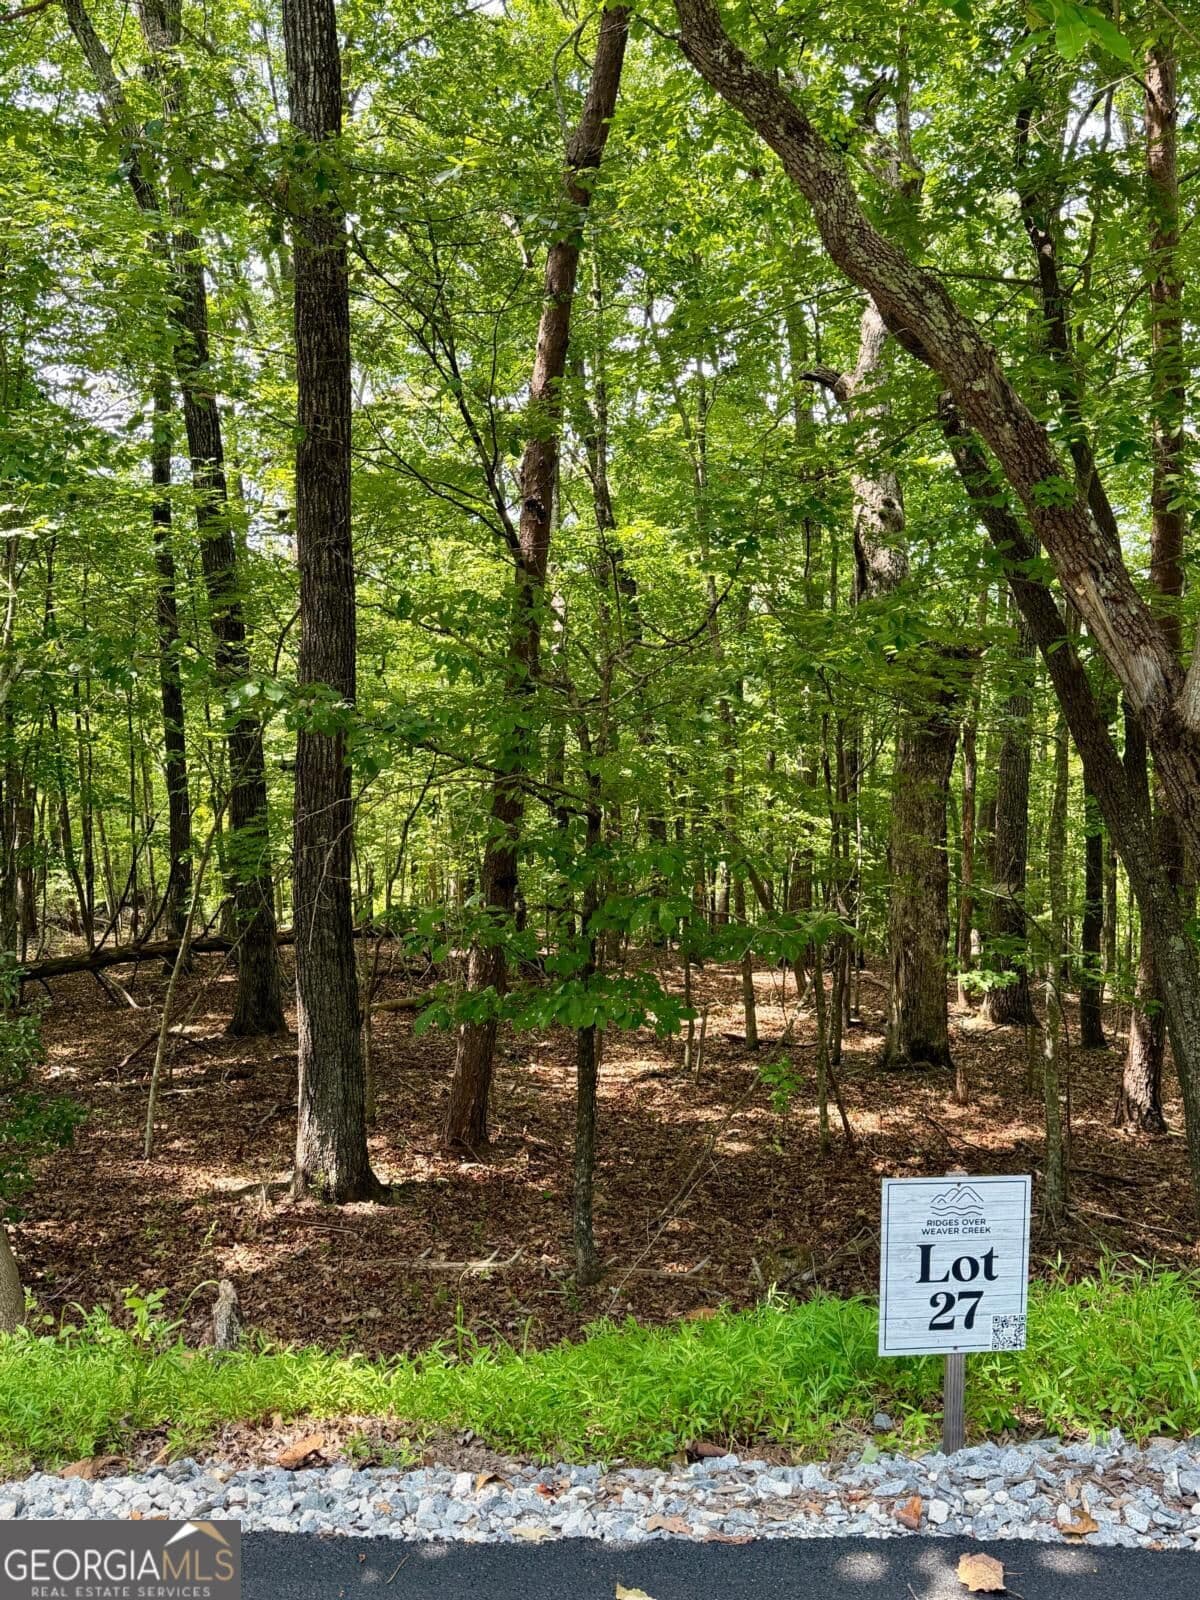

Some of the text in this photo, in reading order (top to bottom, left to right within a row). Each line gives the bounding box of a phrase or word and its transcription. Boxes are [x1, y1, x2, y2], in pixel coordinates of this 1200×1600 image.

[921, 1226, 991, 1235] WEAVER CREEK
[926, 1218, 986, 1227] RIDGES OVER
[915, 1244, 999, 1283] Lot
[928, 1290, 984, 1331] 27
